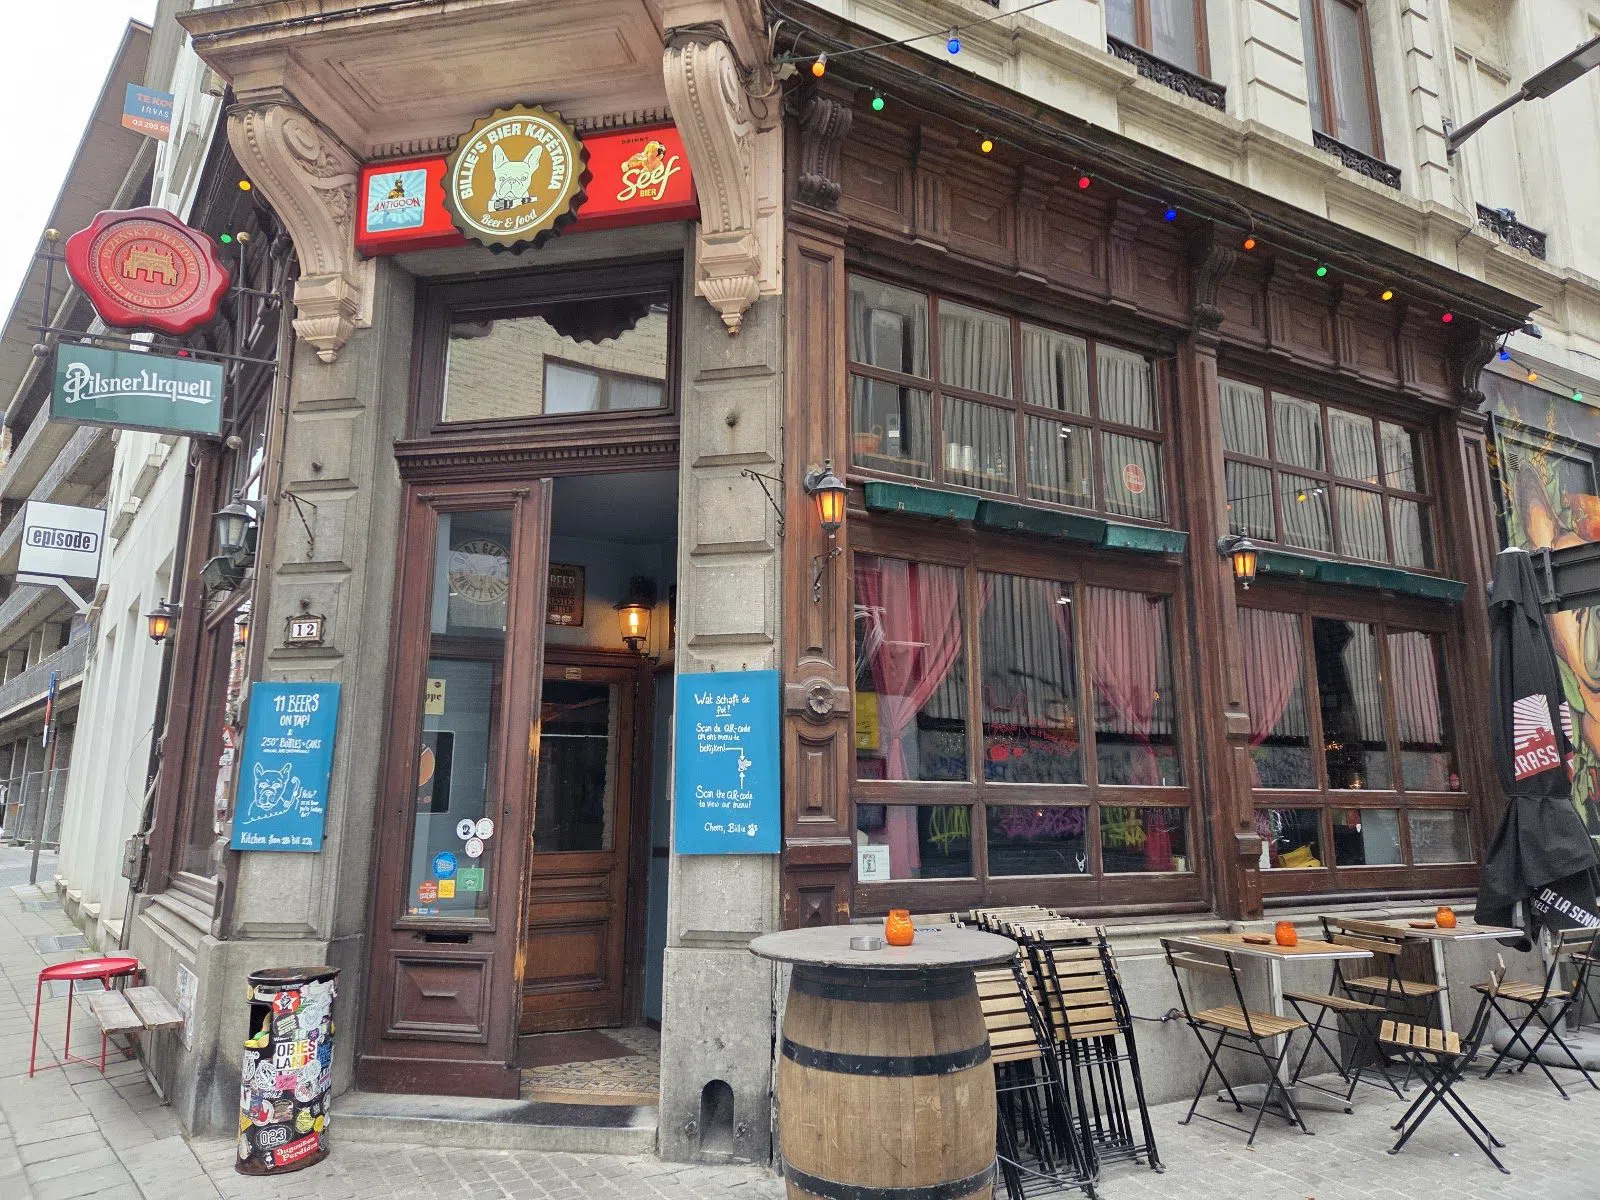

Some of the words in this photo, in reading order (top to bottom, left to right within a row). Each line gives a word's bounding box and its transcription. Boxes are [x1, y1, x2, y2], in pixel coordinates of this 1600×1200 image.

[460, 140, 488, 200] BILLIE'S
[487, 123, 521, 144] BIER
[617, 155, 681, 201] Seef
[640, 188, 657, 197] BIER
[372, 198, 421, 212] ANTIGOON
[480, 214, 503, 228] Beer
[504, 218, 513, 228] &
[514, 209, 537, 229] food
[63, 362, 142, 404] Pilsner
[140, 369, 211, 402] Urquell
[33, 529, 91, 549] episode
[297, 624, 314, 636] 12
[273, 695, 285, 712] 11
[287, 693, 320, 713] BEERS
[694, 691, 714, 705] Wat
[716, 694, 739, 706] schaft
[742, 694, 751, 704] de
[280, 715, 293, 726] ON
[294, 714, 310, 728] TAP!
[696, 723, 712, 733] Scan
[724, 724, 751, 733] QR-code
[1515, 745, 1560, 777] RASS
[696, 785, 713, 799] Scan
[716, 790, 726, 799] the
[727, 790, 753, 801] QR-code
[699, 800, 706, 808] to
[241, 832, 266, 844] Kitchen
[1540, 888, 1558, 905] DE
[1554, 897, 1571, 914] LA
[260, 1128, 287, 1145] 023
